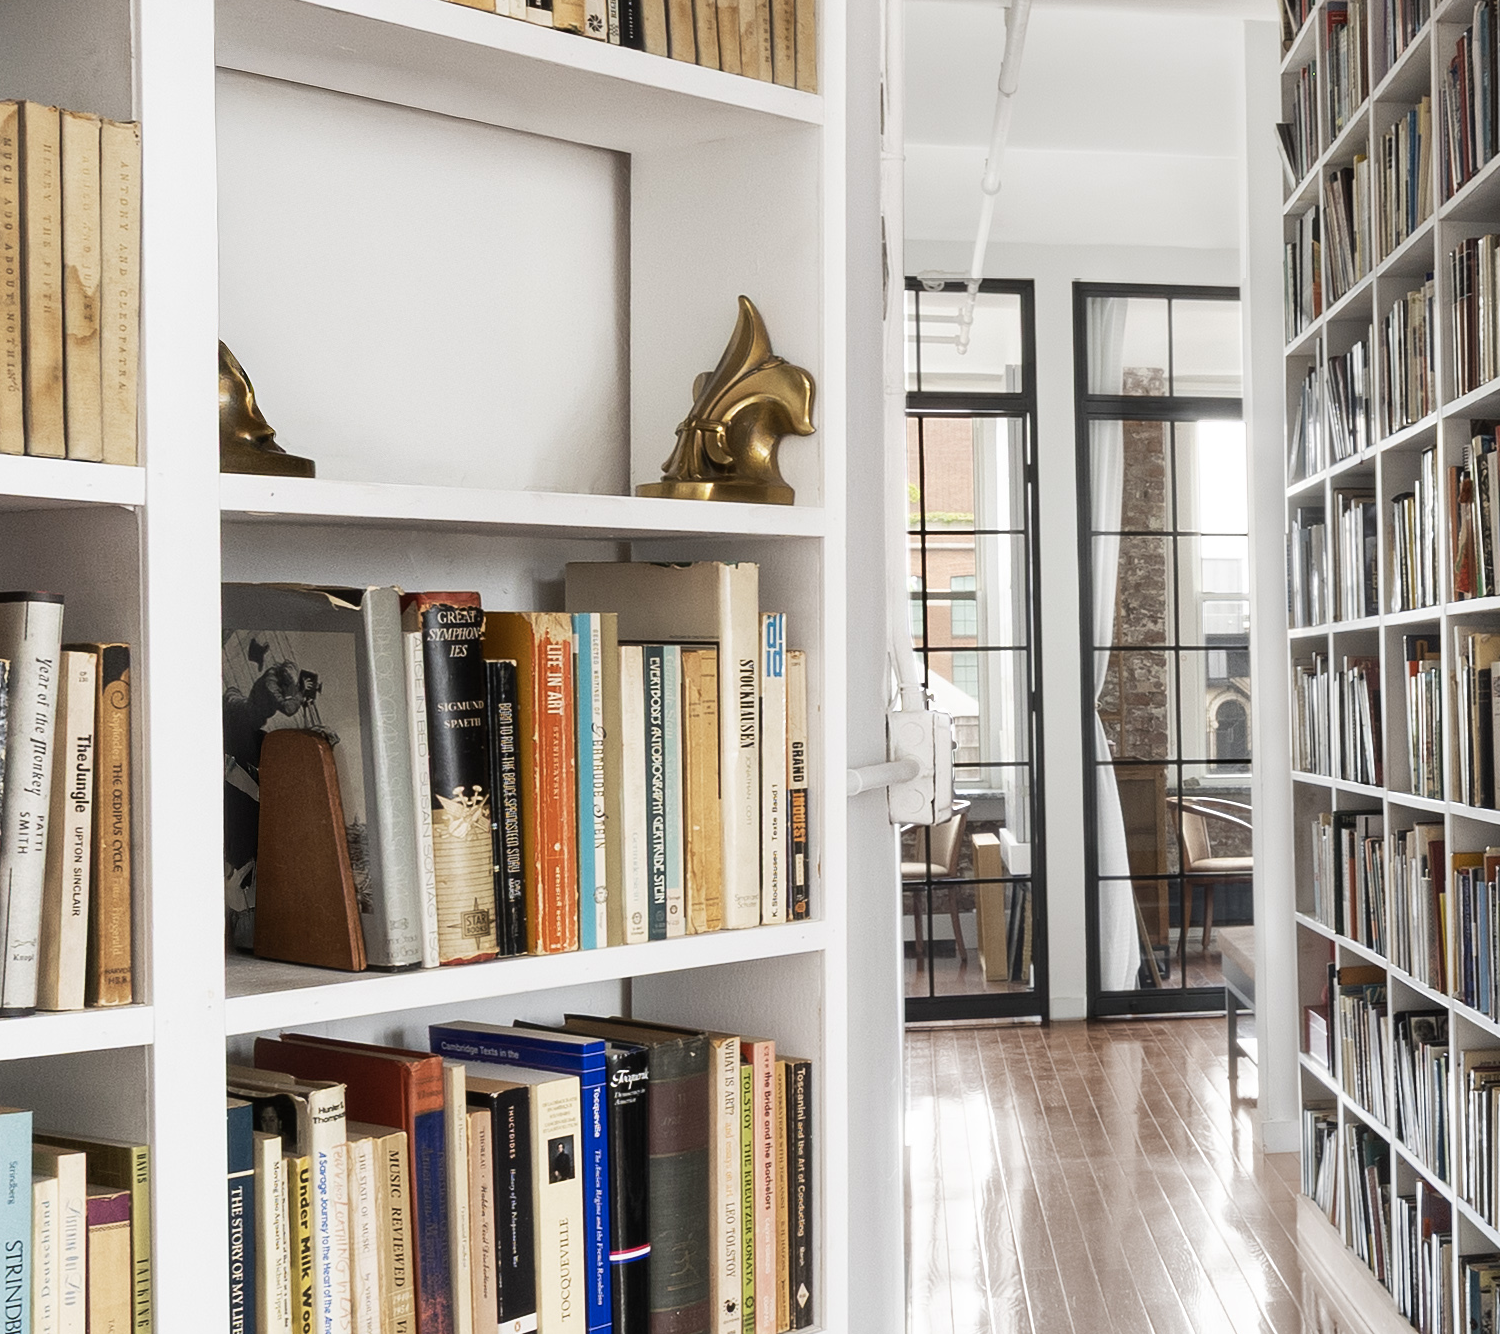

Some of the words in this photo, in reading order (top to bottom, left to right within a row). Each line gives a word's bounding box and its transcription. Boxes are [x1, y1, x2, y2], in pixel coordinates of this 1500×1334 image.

[437, 699, 484, 713] SIGMUND
[443, 717, 482, 730] SPAETH
[738, 658, 755, 750] STOCKHAUSEN
[560, 1219, 572, 1322] TOCQUEVILLE
